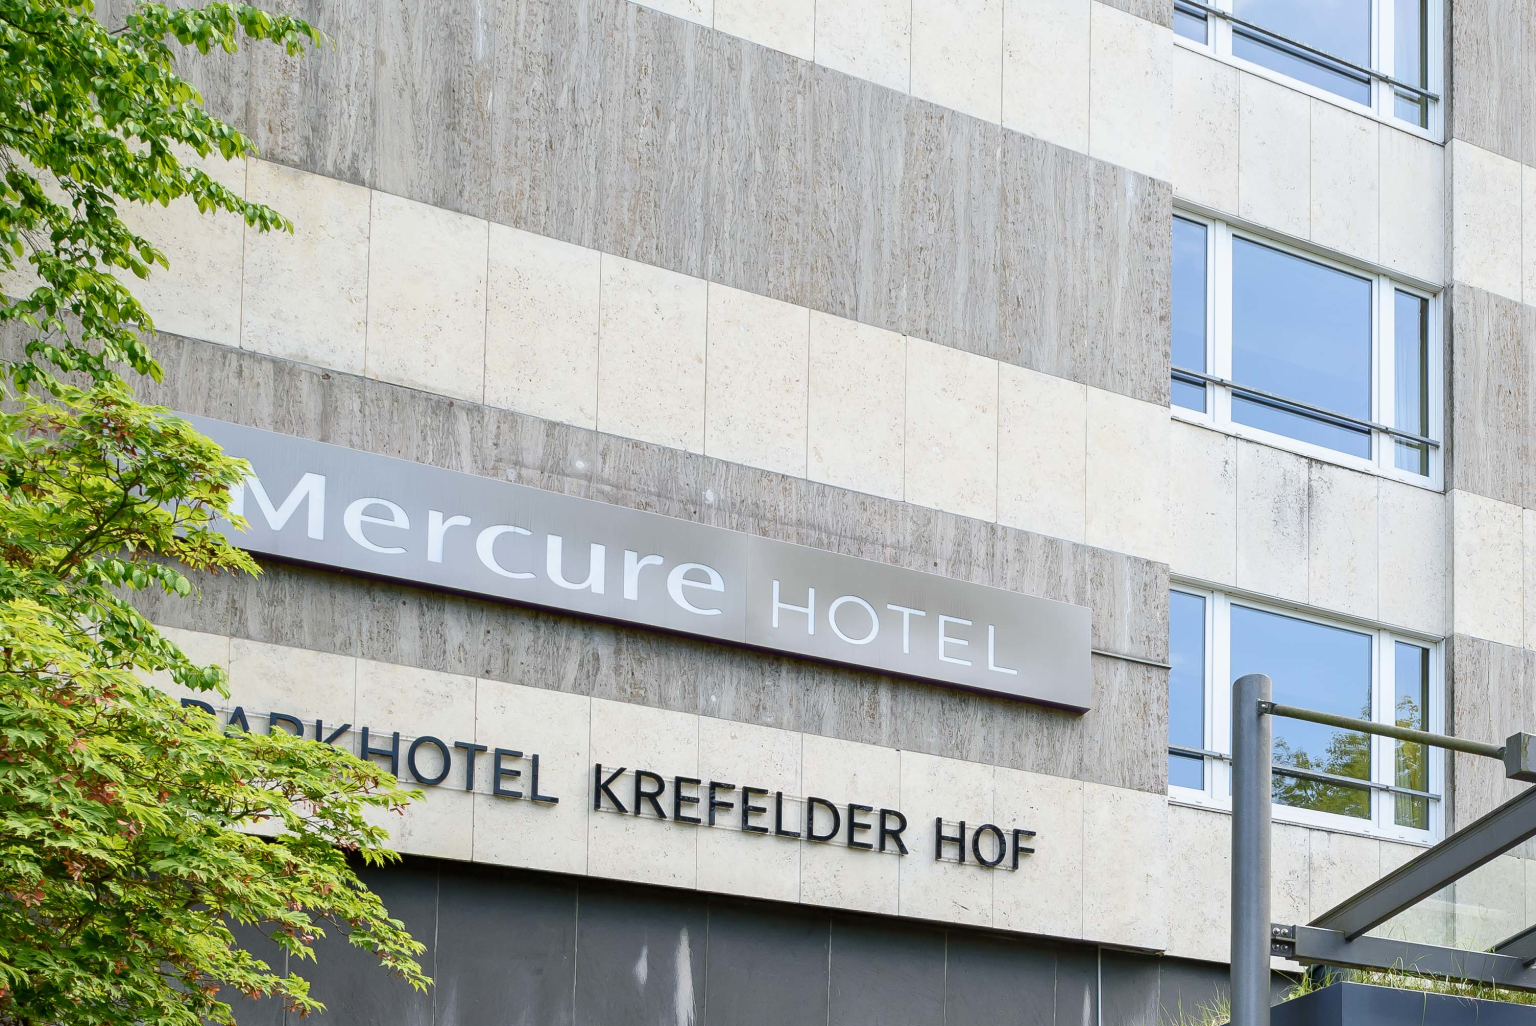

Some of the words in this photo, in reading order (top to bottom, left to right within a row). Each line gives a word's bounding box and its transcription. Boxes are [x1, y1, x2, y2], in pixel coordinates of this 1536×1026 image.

[229, 458, 726, 616] Mercure
[772, 578, 1018, 676] HOTEL
[594, 763, 910, 856] KREFELDER
[935, 816, 1037, 871] HOF
